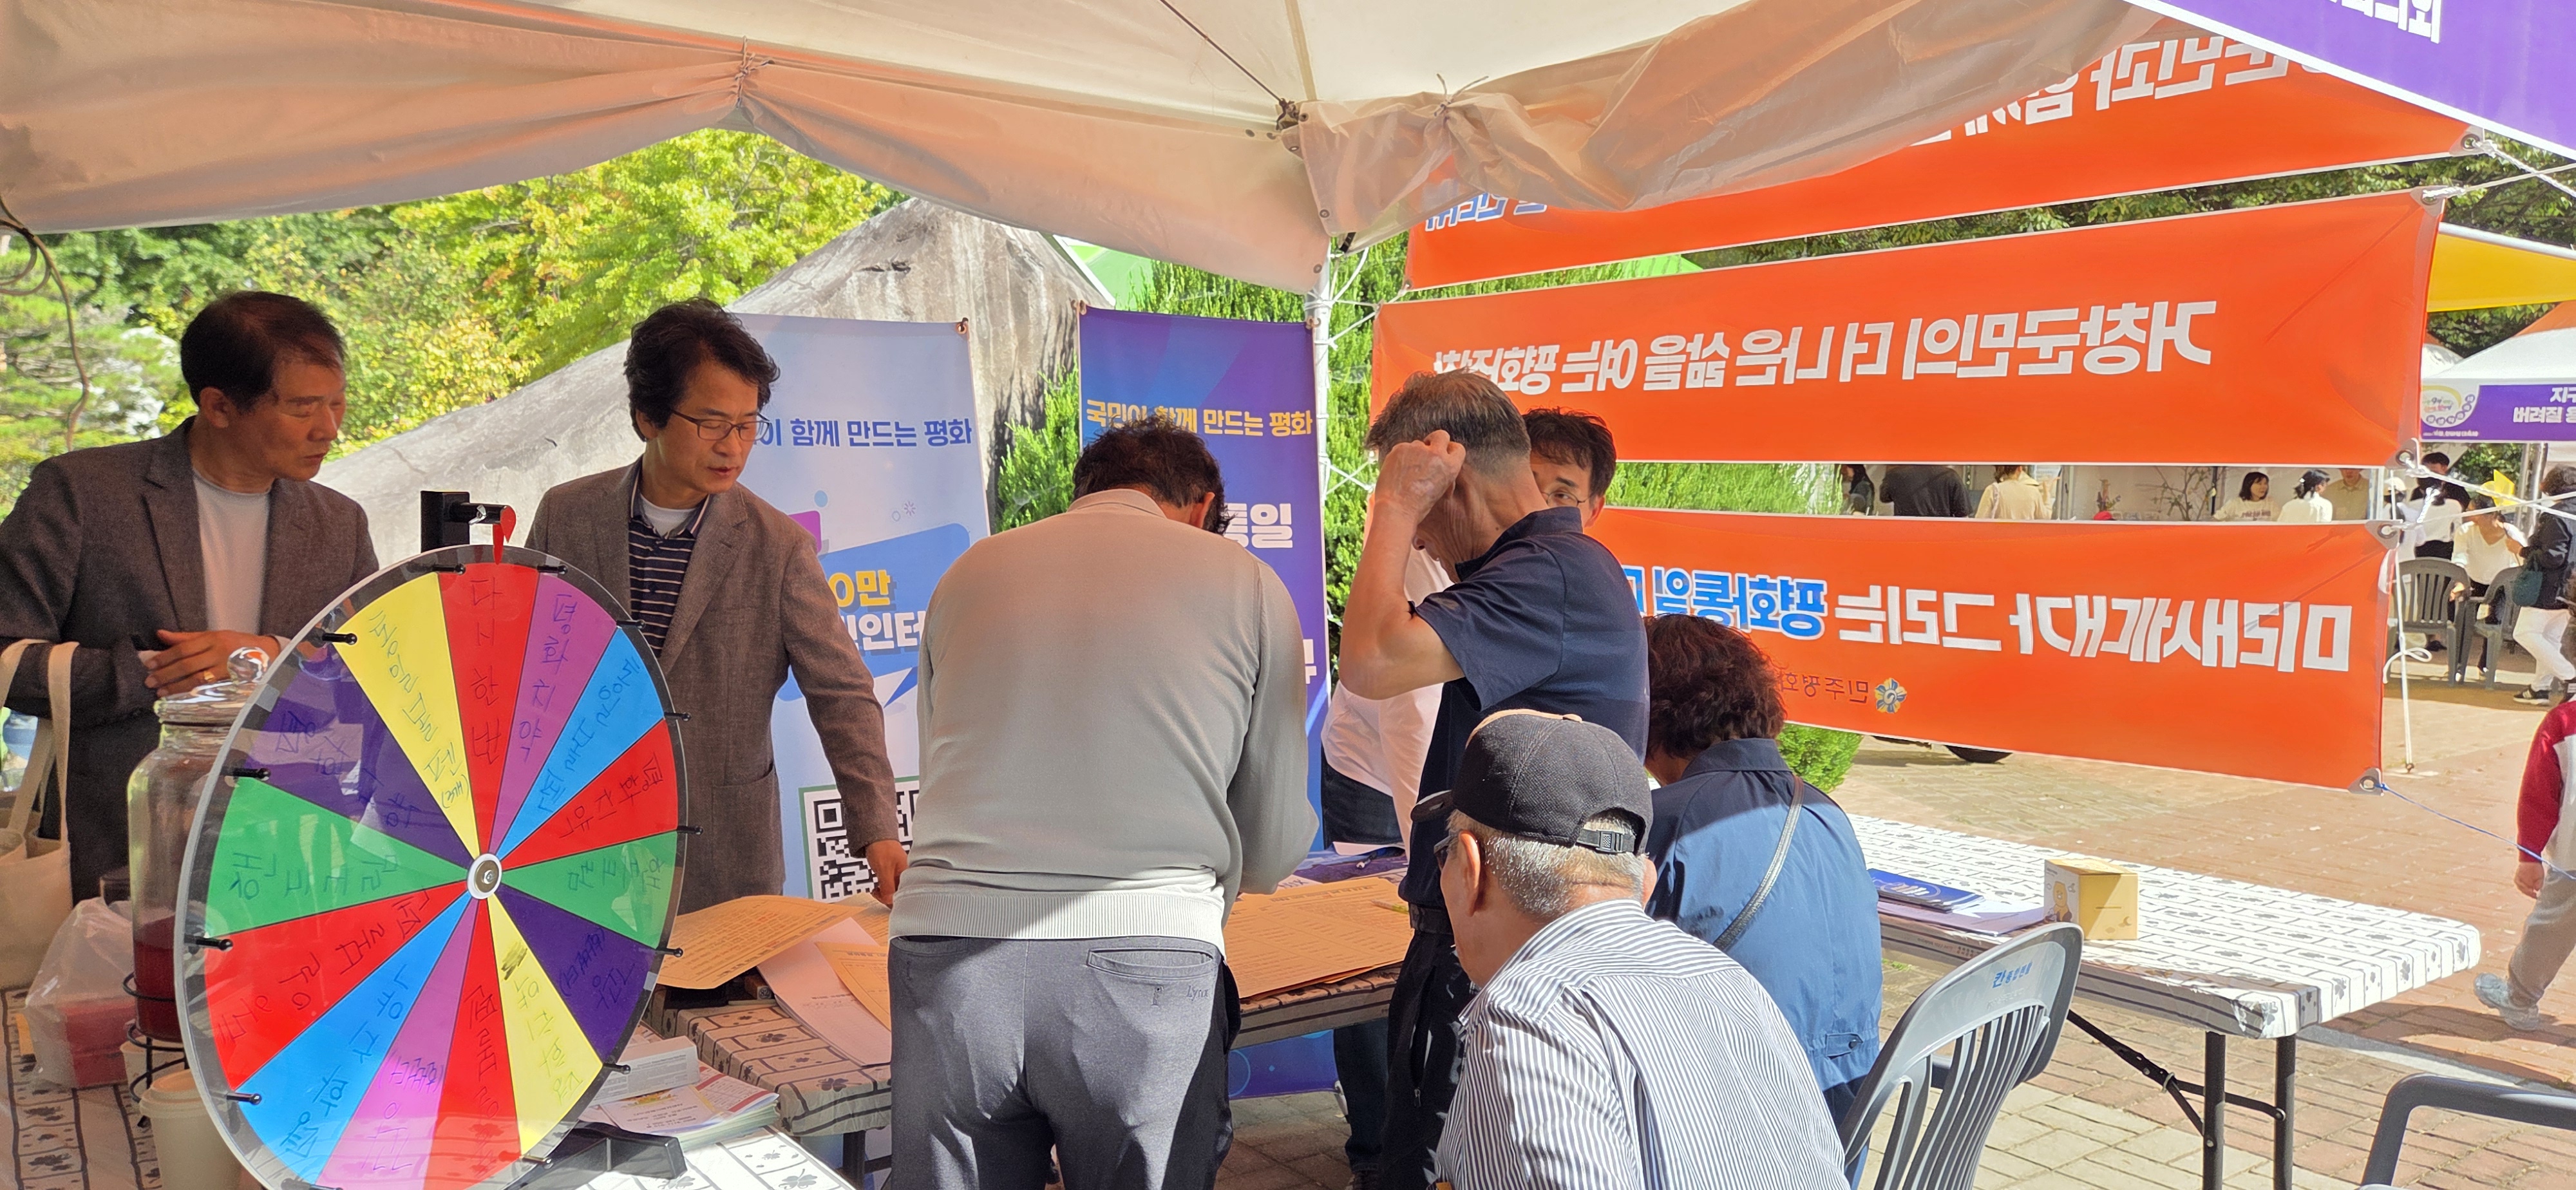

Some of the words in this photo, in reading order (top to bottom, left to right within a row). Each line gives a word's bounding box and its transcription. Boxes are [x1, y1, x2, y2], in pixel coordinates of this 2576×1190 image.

[790, 418, 840, 447] 함께
[847, 420, 918, 447] 만드는
[923, 418, 972, 447] 평화
[1203, 408, 1264, 437] 만드는
[1269, 410, 1313, 437] 평화
[1186, 985, 1210, 1001] Lynx
